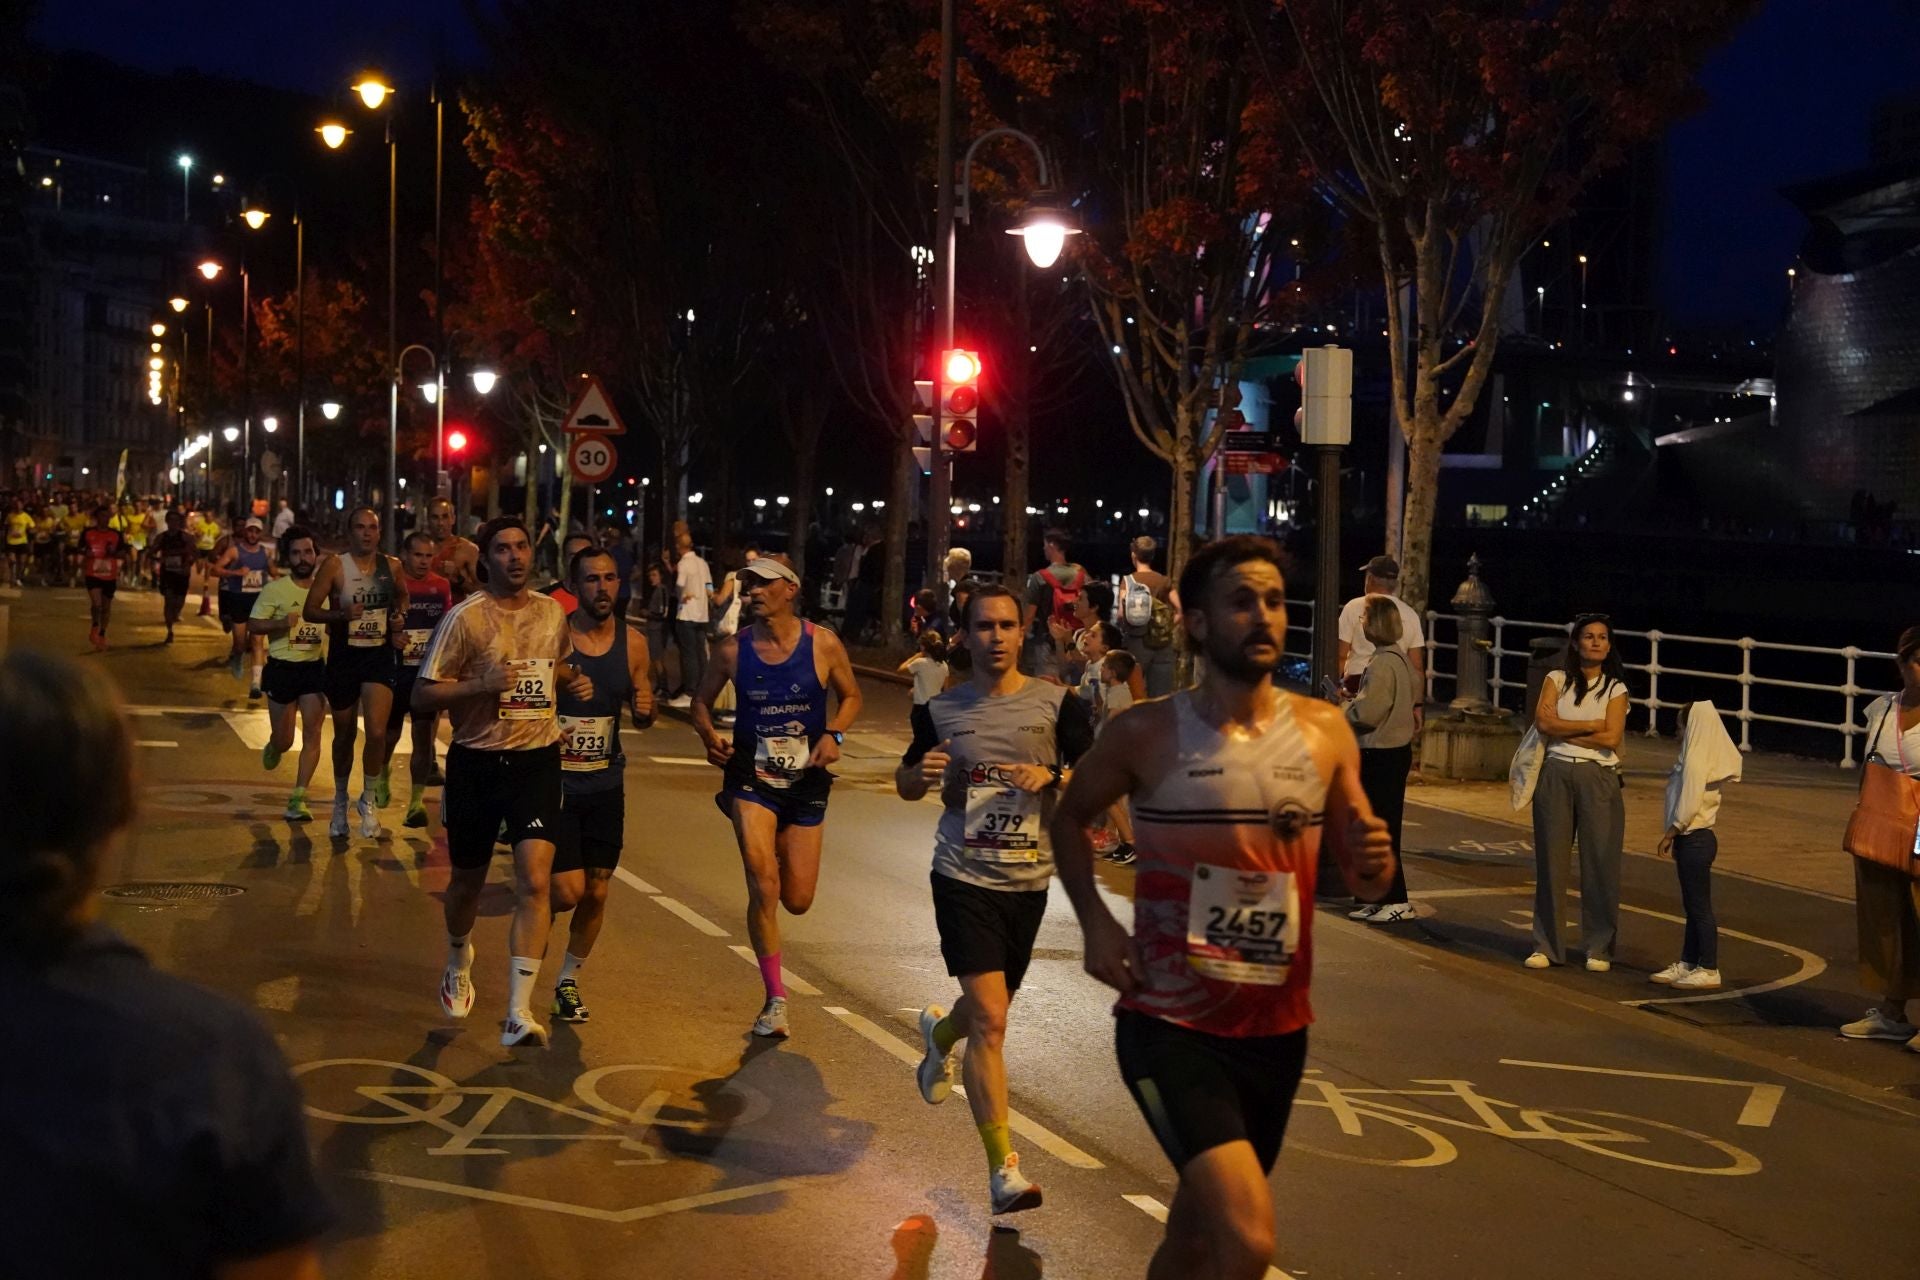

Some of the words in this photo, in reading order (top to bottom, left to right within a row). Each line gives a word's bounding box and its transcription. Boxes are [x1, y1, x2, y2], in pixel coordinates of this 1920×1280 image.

[580, 450, 607, 466] 30
[298, 626, 317, 636] 622
[358, 622, 379, 631] 408
[413, 642, 427, 651] 27
[515, 680, 544, 695] 482
[569, 735, 605, 749] 1933
[766, 756, 797, 769] 592
[984, 813, 1024, 832] 379
[1206, 906, 1288, 938] 2457
